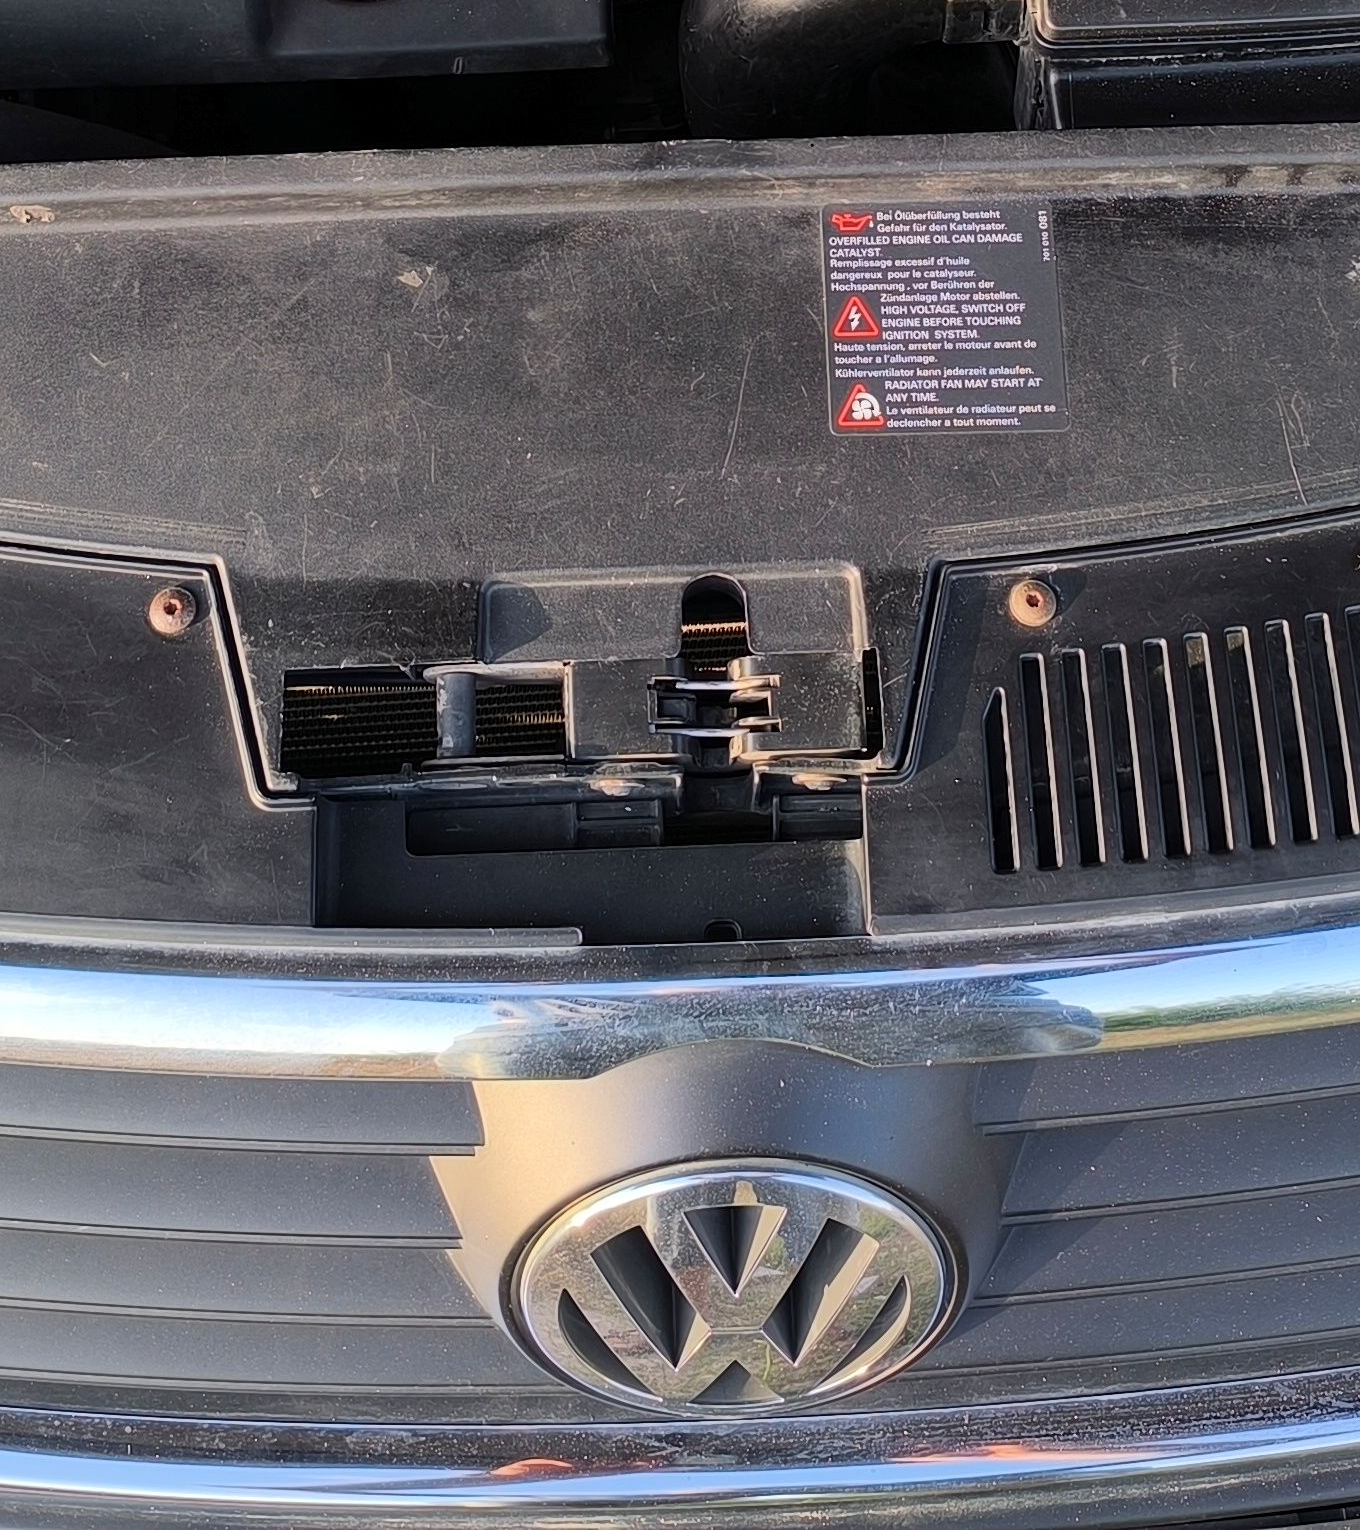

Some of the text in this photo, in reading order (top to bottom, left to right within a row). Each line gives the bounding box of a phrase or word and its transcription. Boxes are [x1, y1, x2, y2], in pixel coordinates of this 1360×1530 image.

[877, 210, 892, 220] Bei
[962, 210, 1000, 219] besteht
[1038, 210, 1048, 229] 081
[877, 222, 1007, 232] Gefahr für den Katalysator.
[829, 233, 1023, 245] OVERFILLED ENGINE OIL CAN DAMAGE
[1041, 232, 1049, 246] 010
[830, 257, 970, 269] Remplissage excessif d'huile
[831, 268, 976, 281] dangereux pour le catalyseur.
[931, 280, 975, 289] Berühren
[978, 280, 994, 288] der
[880, 293, 937, 303] Zündanlage
[973, 291, 1020, 300] abstellen.
[881, 305, 907, 315] HIGH
[961, 304, 1003, 313] SWITCH
[1006, 303, 1026, 312] OFF
[882, 316, 1021, 327] ENGINE BEFORE TOUCHING
[882, 331, 929, 340] IGNITION
[834, 343, 865, 351] Haute
[866, 342, 905, 351] tension,
[944, 341, 953, 349] le
[956, 341, 991, 349] moteur
[994, 340, 1022, 349] avant
[1024, 339, 1037, 348] de
[835, 355, 873, 364] toucher
[835, 365, 1034, 378] Kühlerventilator kann jederzeit anlaufen.
[885, 378, 1043, 389] RADIATOR FAN MAY START AT
[886, 393, 908, 402] ANY
[886, 406, 898, 415] Le
[900, 404, 954, 414] ventilateur
[956, 405, 969, 414] de
[971, 404, 1017, 413] radiateur
[1019, 404, 1042, 414] peut
[976, 417, 1021, 426] moment.
